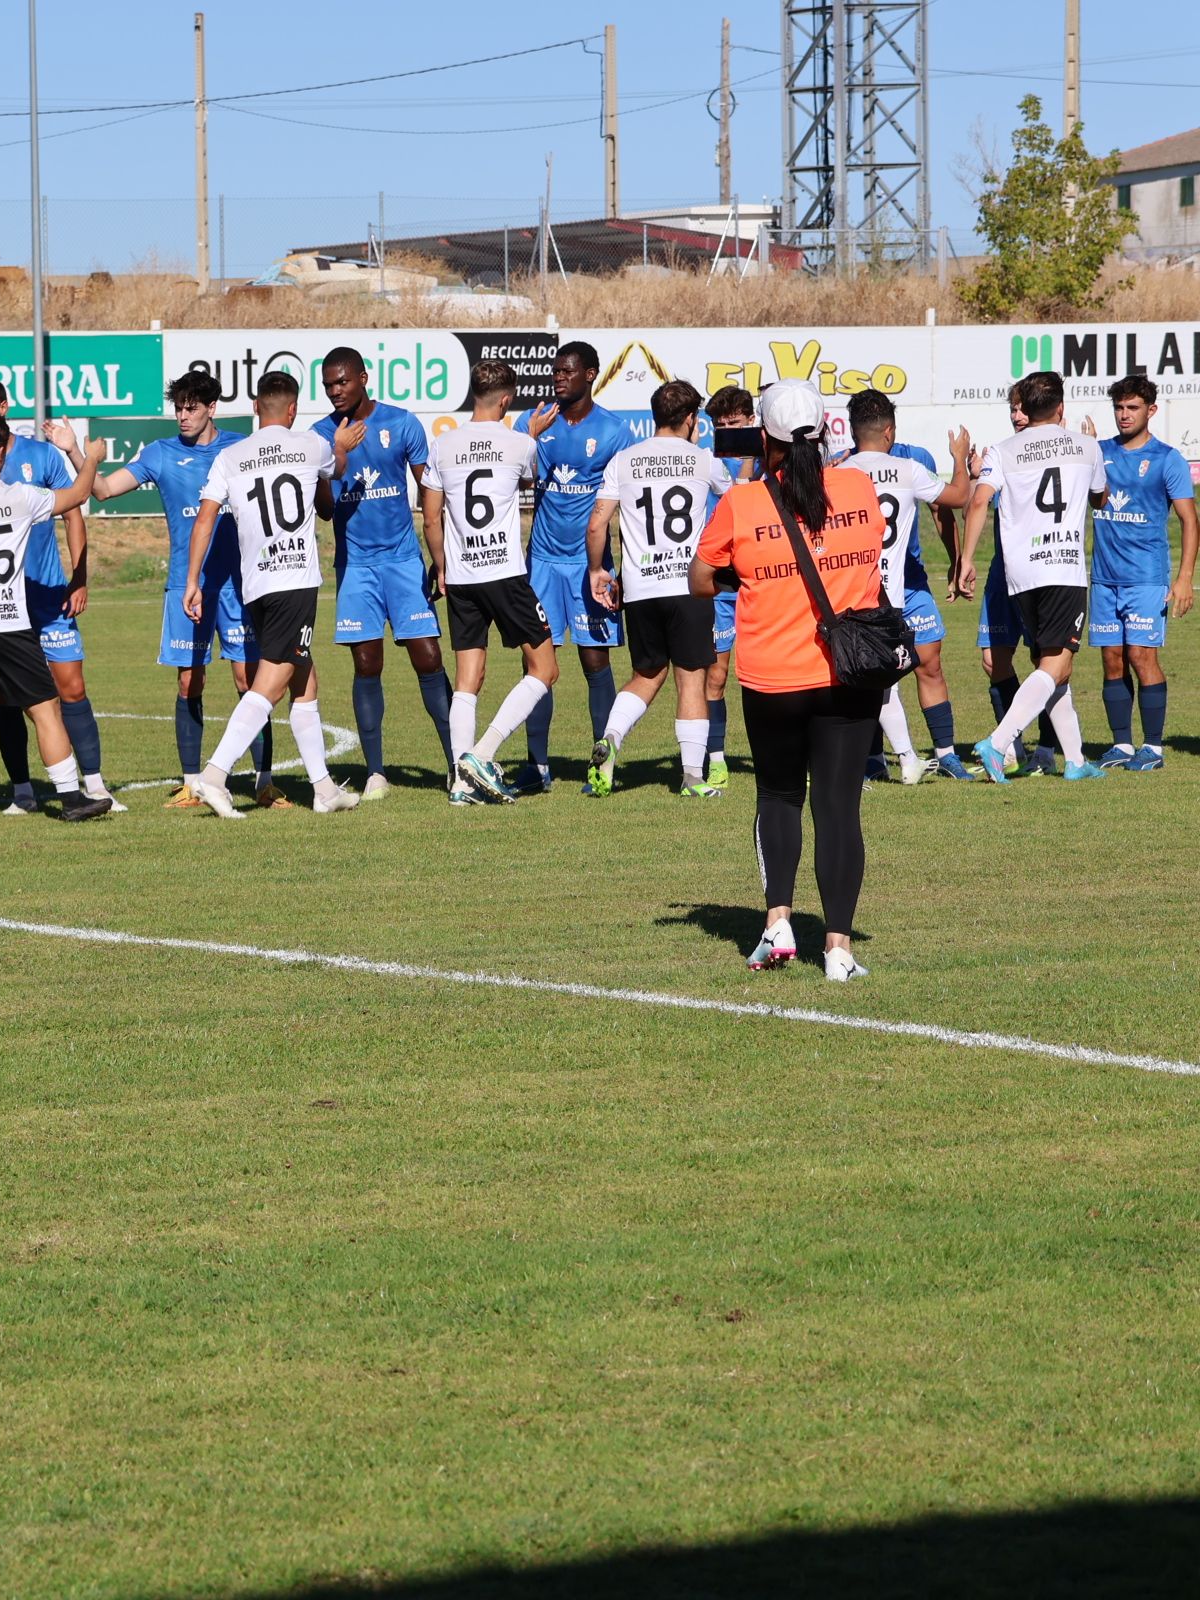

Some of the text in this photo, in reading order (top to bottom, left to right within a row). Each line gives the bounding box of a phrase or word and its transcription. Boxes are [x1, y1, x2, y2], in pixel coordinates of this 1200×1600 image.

[953, 387, 991, 399] PABLO
[470, 441, 492, 451] BAR
[1024, 434, 1073, 452] CARNICERÍA
[259, 445, 282, 456] BAR
[456, 451, 503, 464] LA MARNE
[1016, 445, 1084, 464] MANOLO Y JULIA
[239, 452, 306, 472] SAN FRANCISCO
[631, 455, 696, 467] COMBUSTIBLES
[632, 466, 694, 479] EL REBOLLAR
[365, 486, 400, 500] RURAL
[560, 484, 594, 494] RURAL
[1035, 466, 1067, 524] 4
[246, 473, 306, 537] 10
[465, 468, 495, 529] 6
[636, 485, 693, 546] 18
[1112, 511, 1148, 523] RURAL
[466, 531, 507, 548] MILAR
[1043, 530, 1080, 546] MILAR
[278, 553, 306, 563] VERDE
[479, 547, 508, 558] VERDE
[653, 546, 692, 563] MILAR
[1029, 549, 1079, 562] SIEGA VERDE
[472, 560, 488, 568] CASA
[754, 561, 800, 581] CIUDA
[818, 548, 876, 572] RODRIGO
[1062, 558, 1079, 566] RURAL
[640, 562, 689, 577] SIEGA VERD
[676, 571, 689, 579] RUR
[0, 612, 20, 621] RURAL
[535, 602, 547, 622] 6
[1074, 611, 1085, 632] 4
[300, 624, 313, 647] 10
